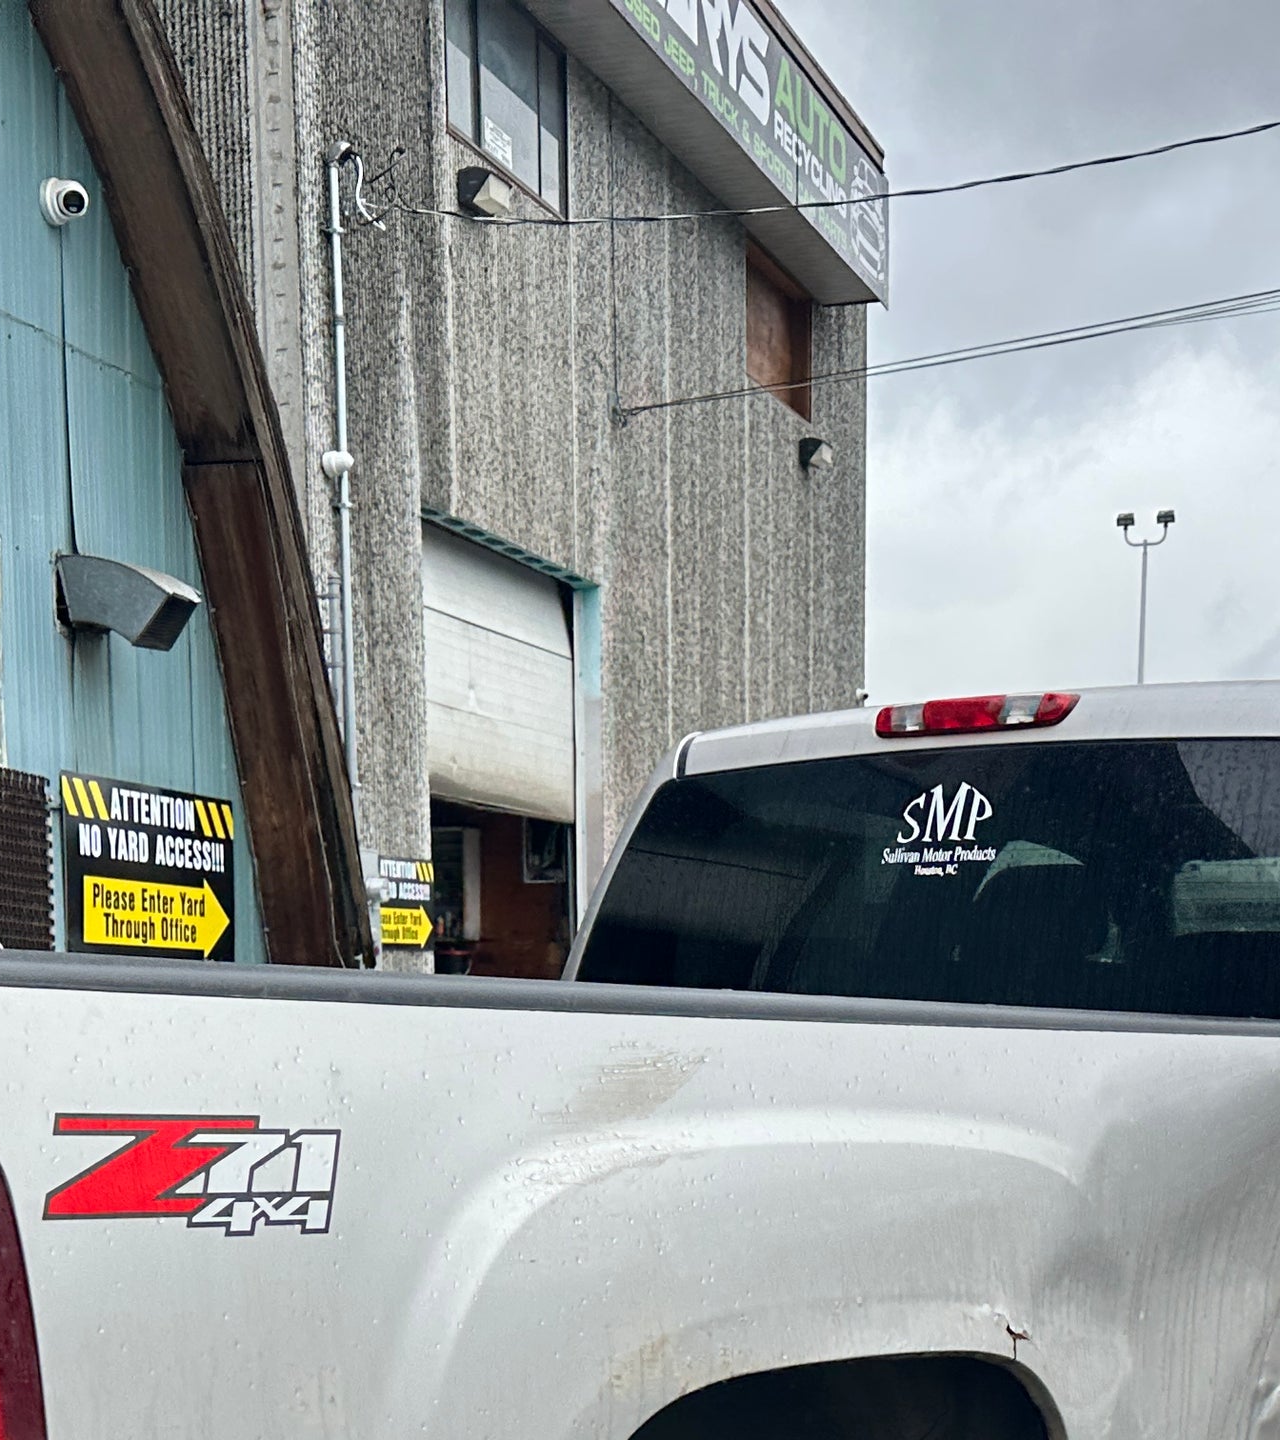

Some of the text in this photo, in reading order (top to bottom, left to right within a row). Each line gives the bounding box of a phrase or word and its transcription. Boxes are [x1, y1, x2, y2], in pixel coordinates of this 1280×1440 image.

[657, 0, 847, 185] RYS AUTO
[664, 33, 698, 92] JEEP,
[701, 70, 740, 132] TRUCK
[742, 118, 751, 144] &
[752, 132, 794, 193] SPORTS
[773, 110, 847, 219] RECYCLING
[110, 787, 196, 832] ATTENTION
[896, 781, 993, 843] SMP
[78, 823, 225, 873] NO YARD ACCESS!!!
[881, 845, 997, 864] Sullivan Motor Products
[92, 883, 206, 918] Please Enter Yard
[103, 913, 197, 944] Through Office
[42, 1113, 341, 1220] Z71
